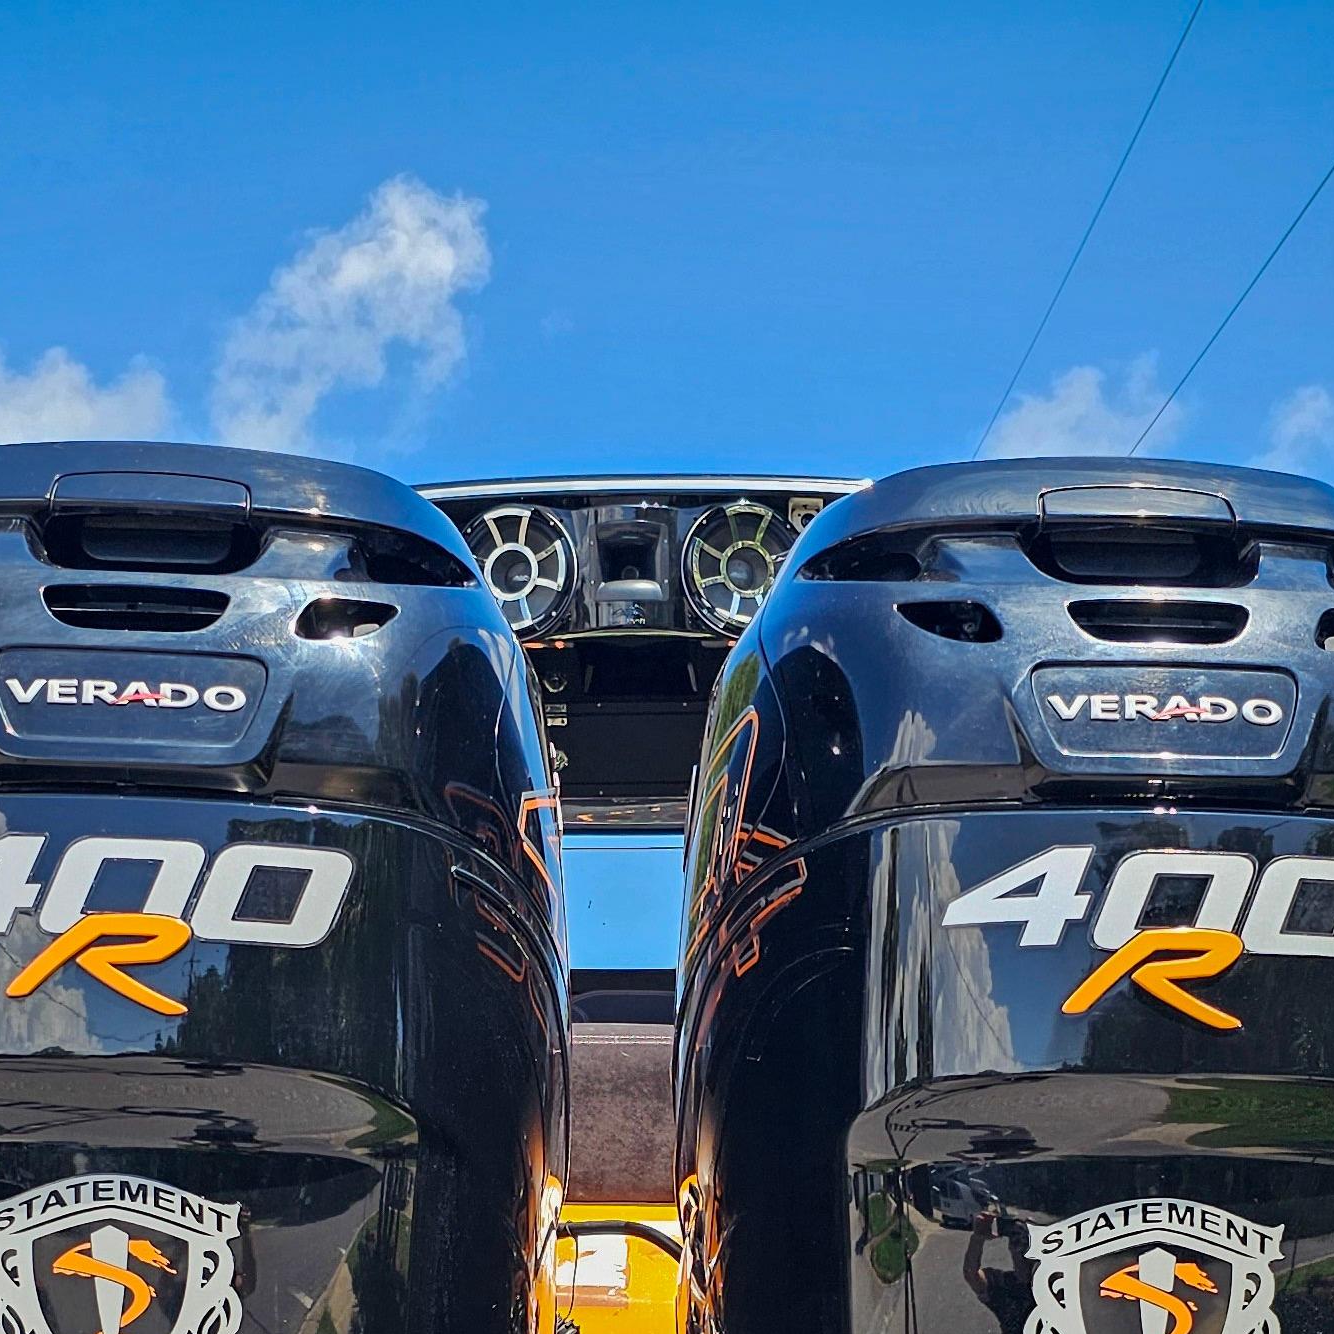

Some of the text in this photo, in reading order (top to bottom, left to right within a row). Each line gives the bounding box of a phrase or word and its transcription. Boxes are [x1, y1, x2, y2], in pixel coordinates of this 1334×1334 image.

[5, 678, 247, 712] VERADO
[1047, 693, 1284, 726] VERADO
[5, 913, 192, 1016] R
[1061, 927, 1244, 1030] R
[1040, 1201, 1274, 1255] STATEMENT
